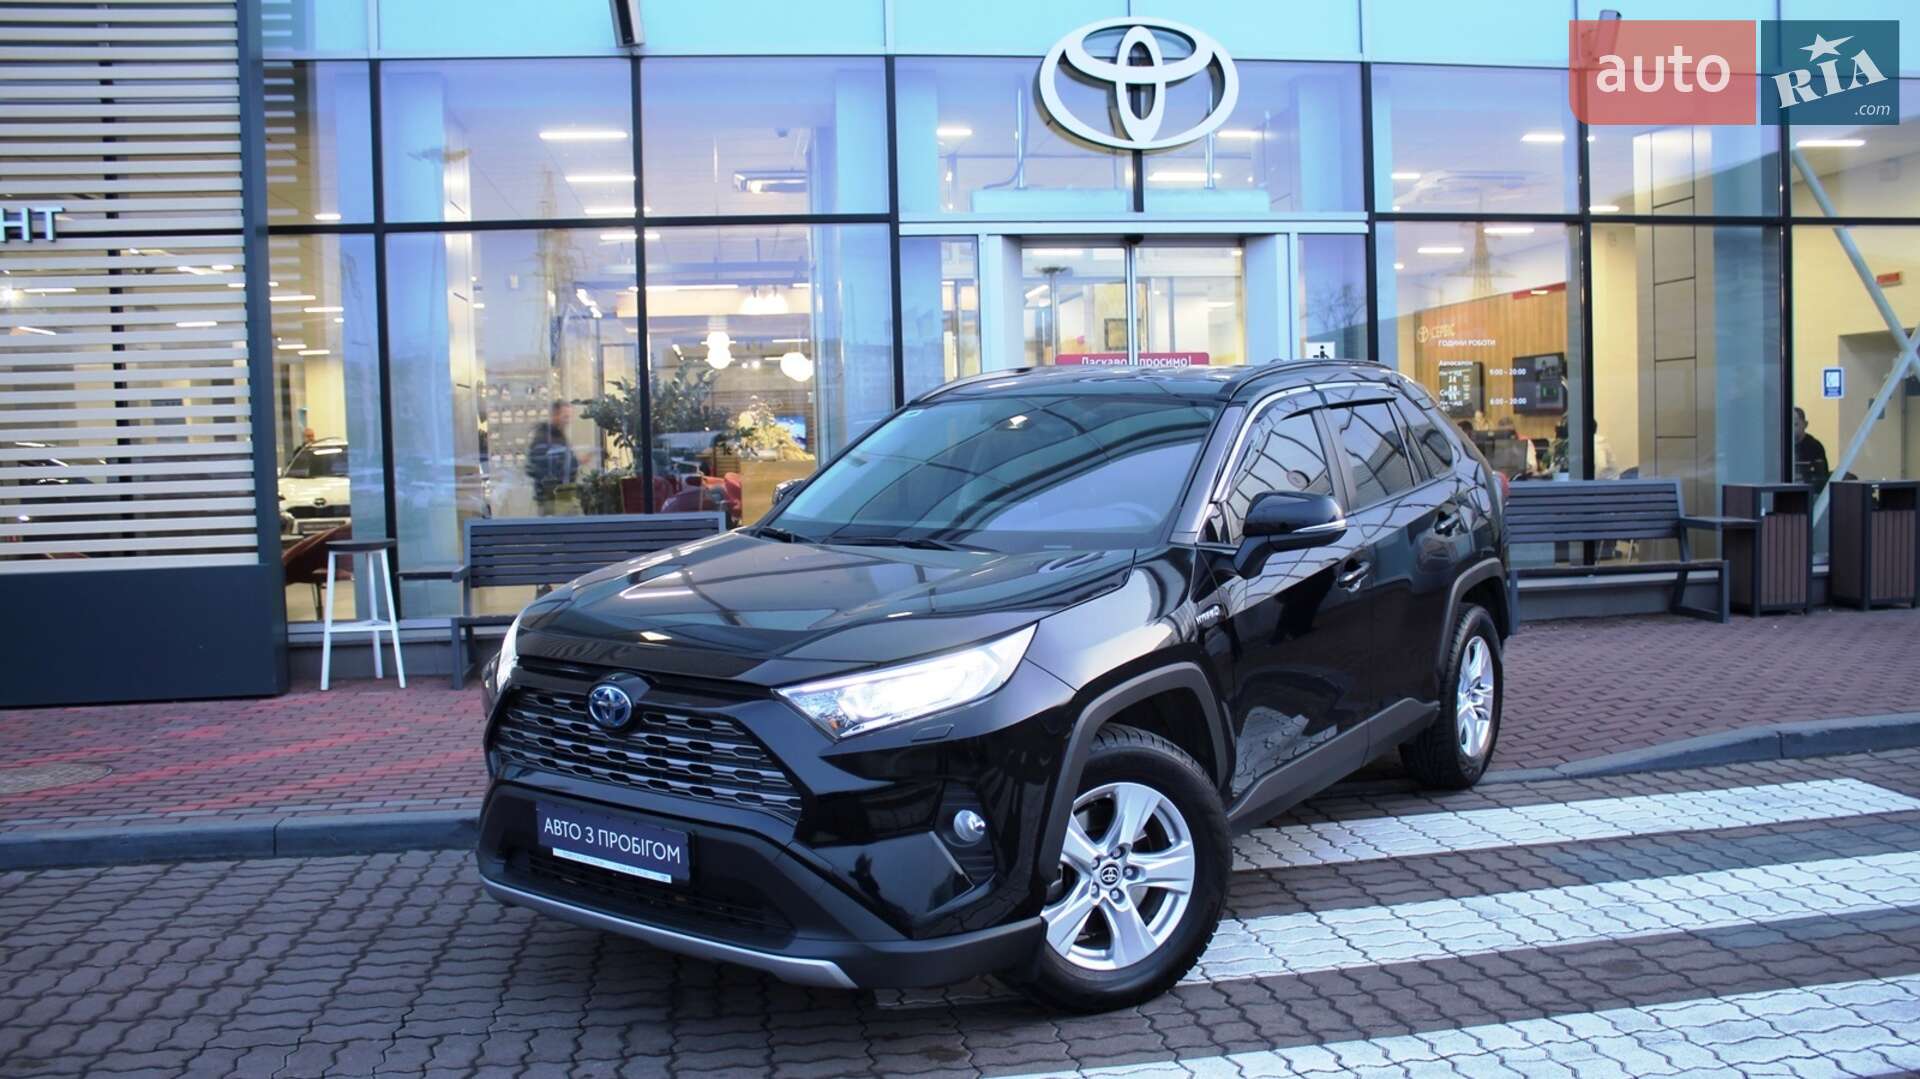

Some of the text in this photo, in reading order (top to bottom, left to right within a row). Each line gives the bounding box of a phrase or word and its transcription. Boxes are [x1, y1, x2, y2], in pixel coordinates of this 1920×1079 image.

[1139, 355, 1191, 368] просимо!
[544, 817, 582, 841] АВТО
[598, 828, 681, 864] ПРОБІГОМ
